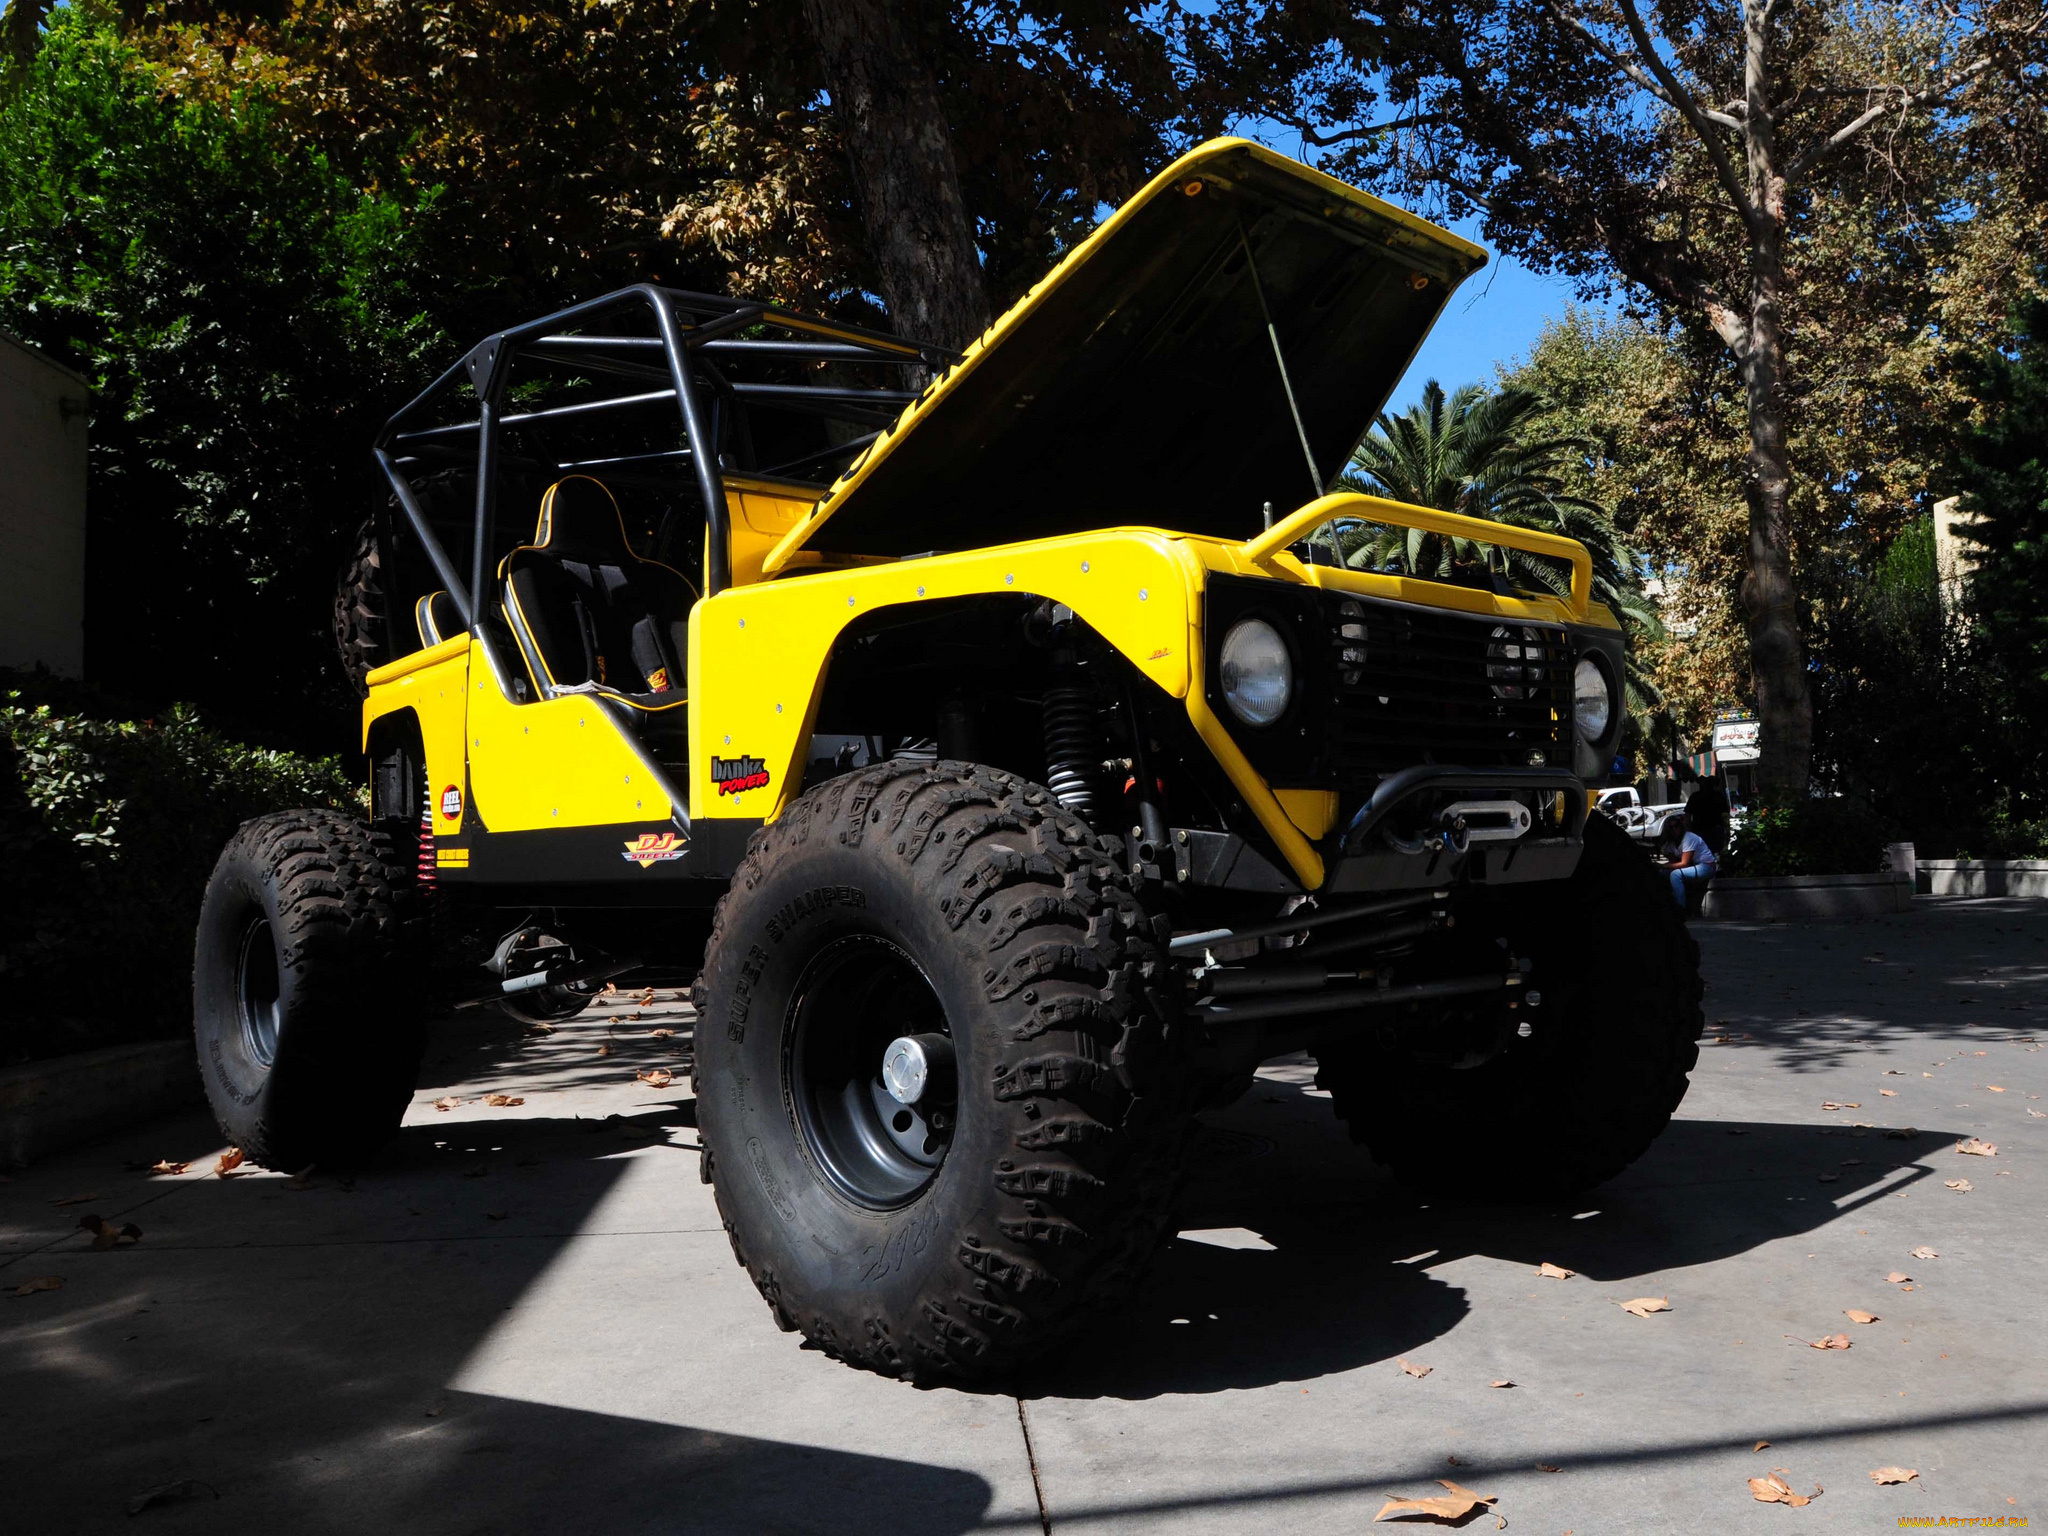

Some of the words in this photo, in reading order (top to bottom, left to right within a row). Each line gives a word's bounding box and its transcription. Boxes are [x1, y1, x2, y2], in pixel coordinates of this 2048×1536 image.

[719, 771, 769, 794] POWER
[636, 833, 675, 850] DJ
[631, 852, 675, 860] SAFETY
[727, 943, 769, 1044] SUPER
[764, 884, 867, 944] SWAMPER
